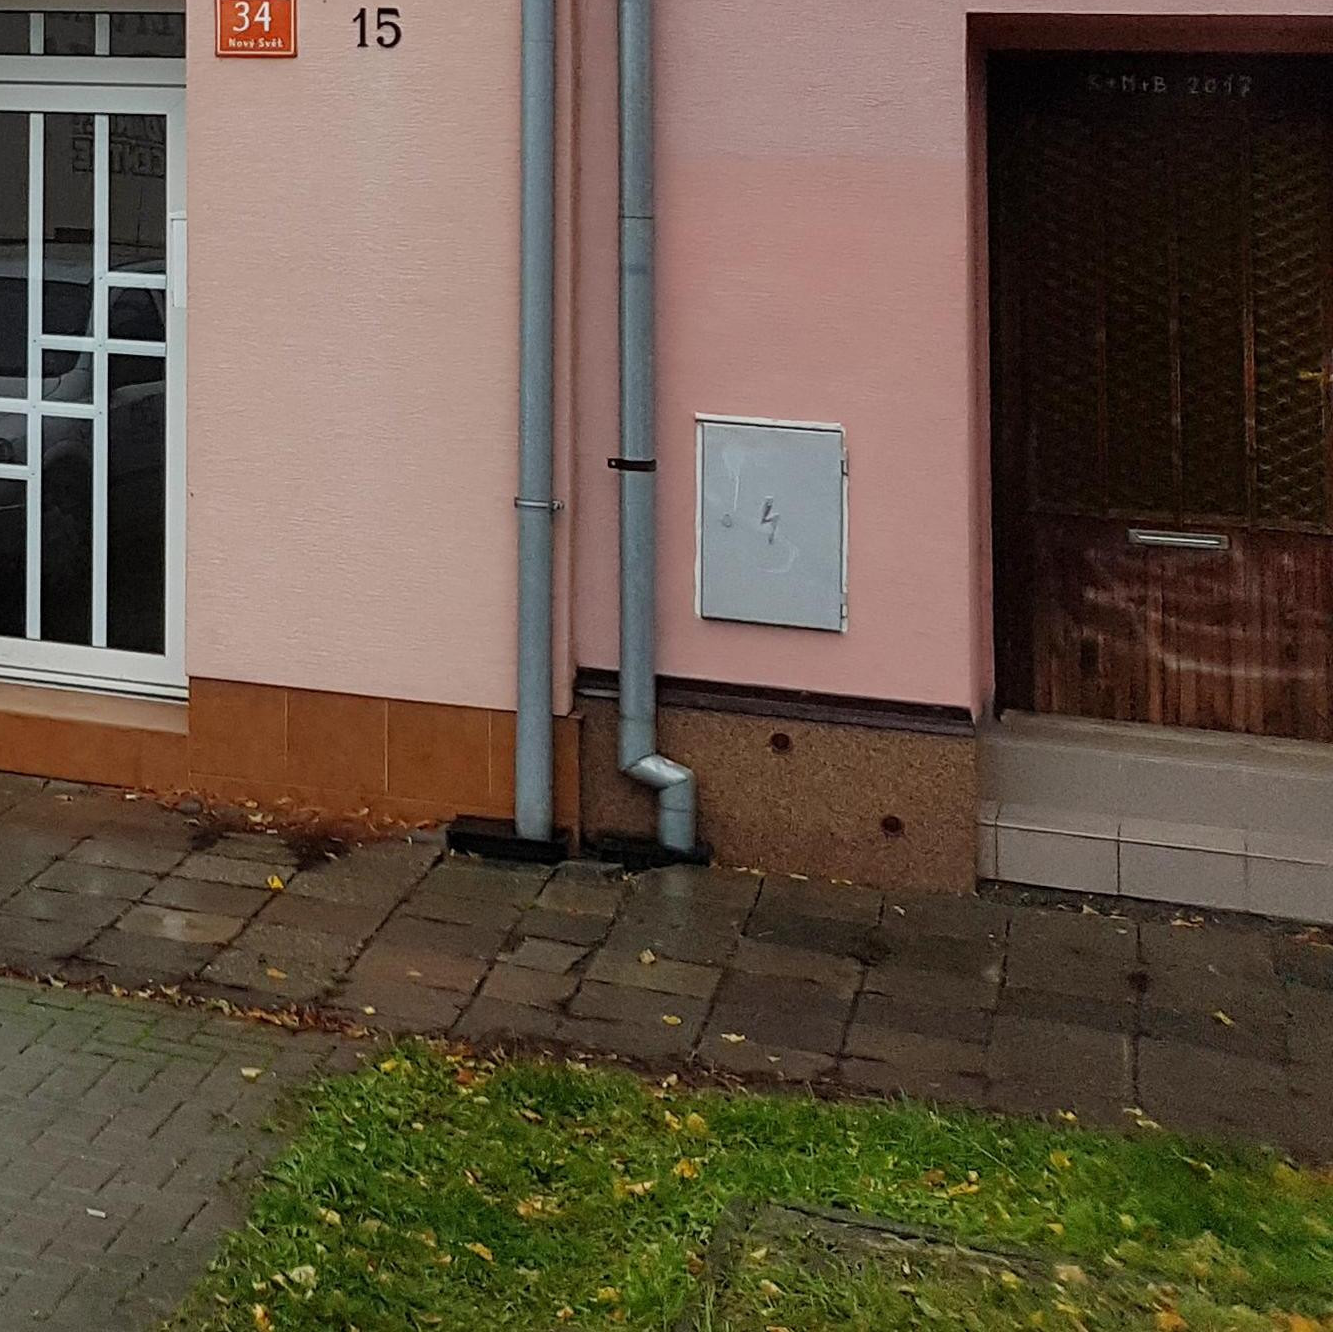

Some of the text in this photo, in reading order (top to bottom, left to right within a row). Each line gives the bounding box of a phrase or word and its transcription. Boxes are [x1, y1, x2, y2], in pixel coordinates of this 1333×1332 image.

[233, 1, 272, 32] 34
[353, 8, 402, 48] 15
[228, 37, 284, 49] Nový Svět
